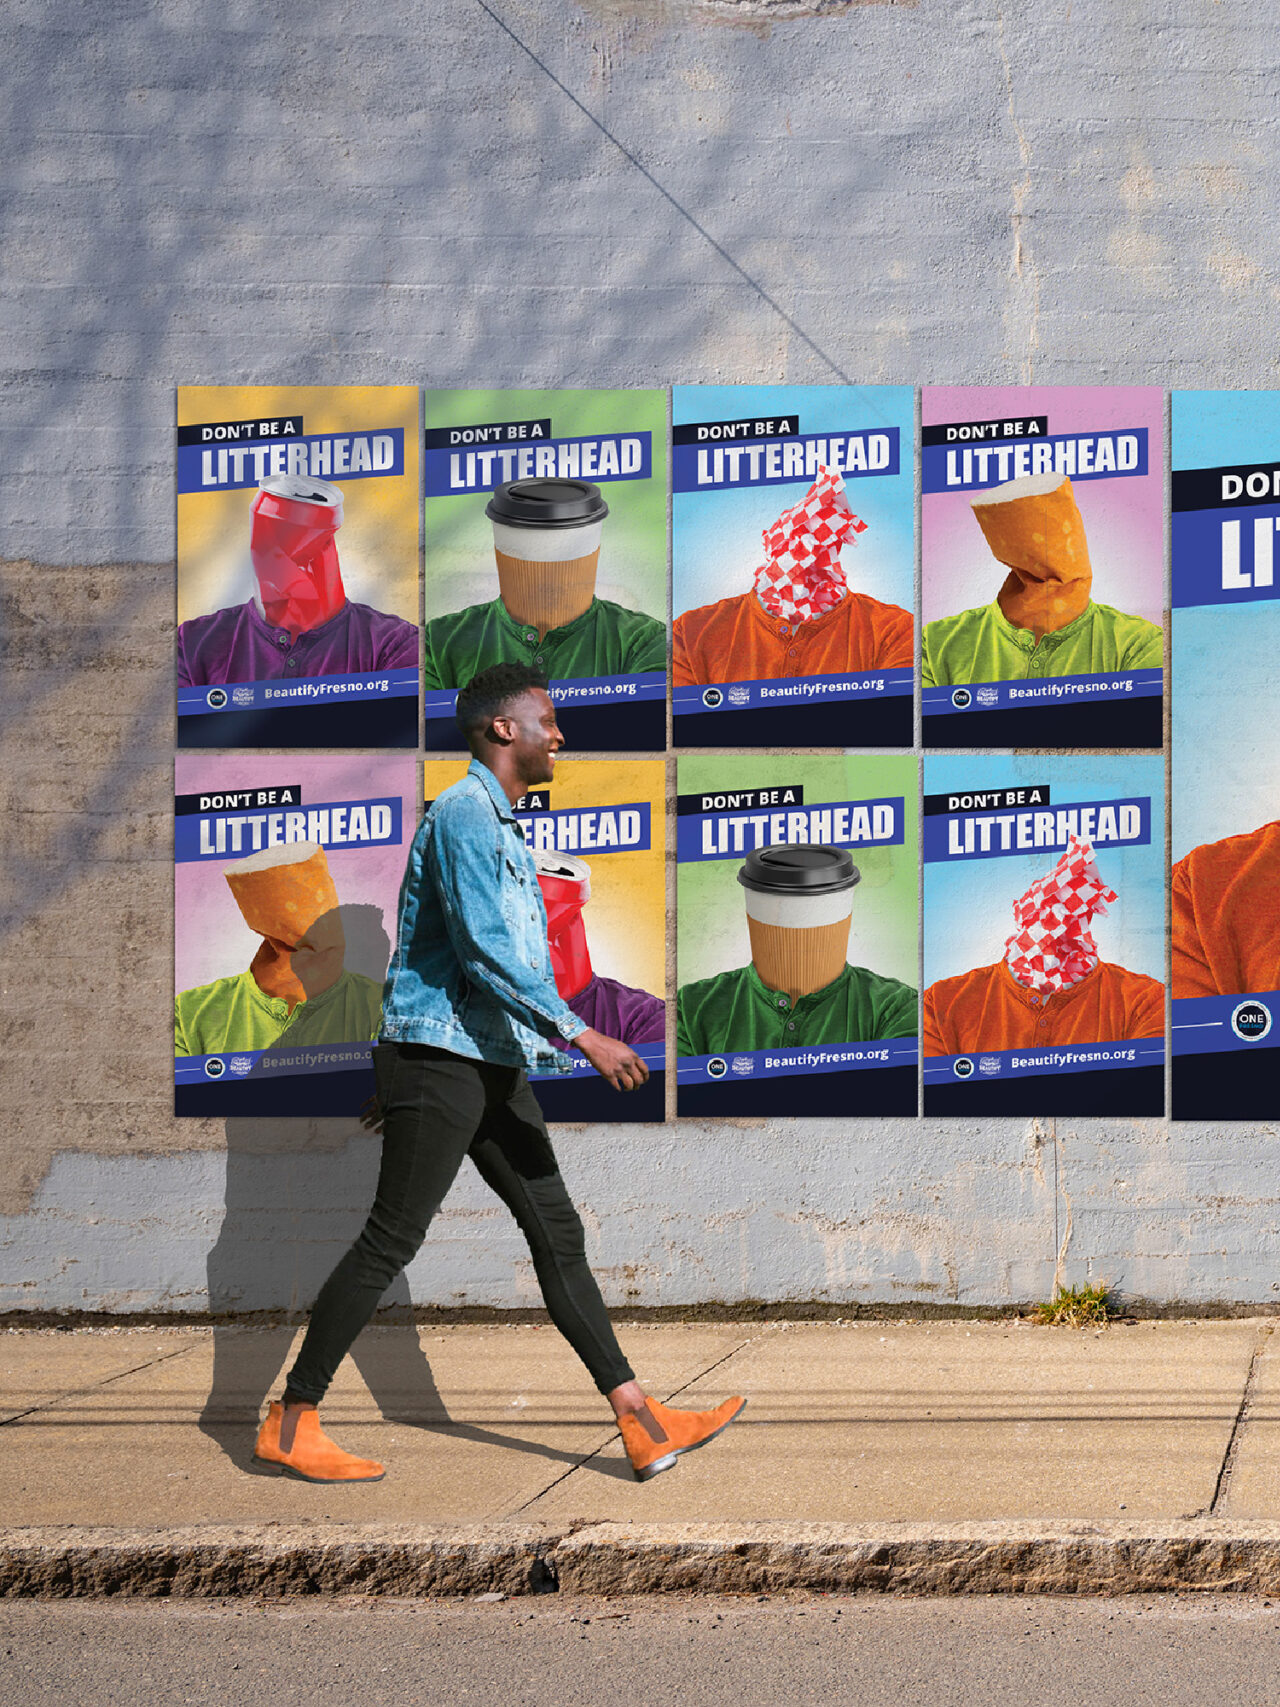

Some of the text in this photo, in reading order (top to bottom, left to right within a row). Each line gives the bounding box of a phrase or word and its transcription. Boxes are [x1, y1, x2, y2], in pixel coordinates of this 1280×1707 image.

[202, 420, 295, 441] DON'T BE A
[449, 424, 543, 445] DON'T BE A
[697, 420, 791, 441] DON'T BE A
[946, 421, 1040, 441] DON'T BE A
[202, 435, 394, 485] LITTERHEAD
[449, 439, 642, 489] LITTERHEAD
[697, 435, 889, 485] LITTERHEAD
[946, 435, 1138, 486] LITTERHEAD
[265, 680, 388, 698] BeautifyFresno.org
[546, 682, 637, 702] tifyFresno.org
[760, 680, 884, 698] BeautifyFresno.org
[1009, 680, 1133, 699] BeautifyFresno.org
[200, 789, 293, 810] DON'T BE A
[511, 795, 543, 809] E A
[702, 789, 795, 810] DON'T BE A
[948, 789, 1042, 810] DON'T BE A
[200, 804, 392, 855] LITTERHEAD
[516, 810, 641, 851] ERHEAD
[702, 804, 894, 855] LITTERHEAD
[948, 804, 1141, 855] LITTERHEAD
[1239, 1014, 1264, 1023] ONE
[262, 1051, 372, 1069] BeautifyFresno.o
[765, 1049, 888, 1068] BeautifyFresno.org
[1011, 1049, 1135, 1068] BeautifyFresno.org
